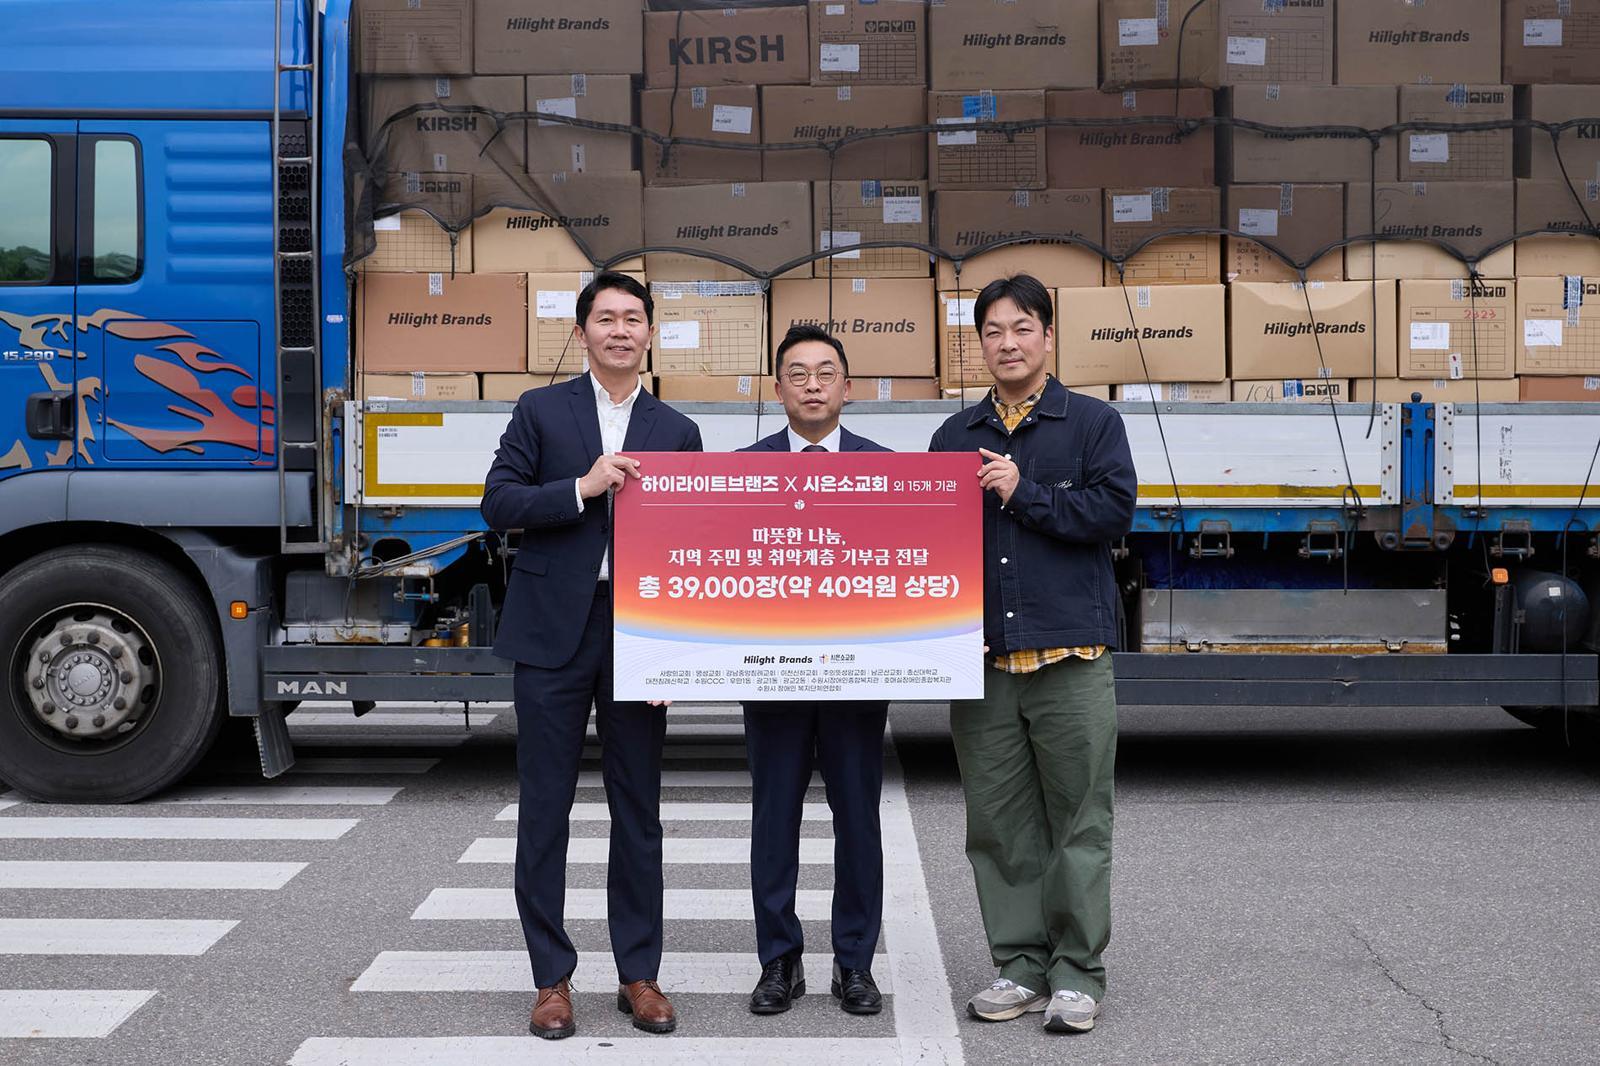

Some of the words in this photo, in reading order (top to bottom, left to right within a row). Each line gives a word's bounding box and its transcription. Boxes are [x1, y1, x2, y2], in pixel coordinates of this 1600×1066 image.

[507, 18, 556, 32] Hilight
[558, 18, 610, 30] Brands
[963, 34, 1013, 48] Hilight
[1014, 34, 1066, 46] Brands
[1369, 30, 1416, 46] Hilight
[1419, 30, 1470, 42] Brands
[669, 35, 784, 65] KIRSH
[417, 117, 477, 131] KIRSH
[1577, 124, 1600, 139] KI
[793, 126, 842, 140] Hilight
[1079, 132, 1128, 147] Hilight
[1130, 132, 1182, 145] Brands
[506, 217, 556, 231] Hilight
[557, 214, 610, 228] Brands
[677, 226, 724, 240] Hilight
[727, 224, 778, 237] Brands
[1431, 225, 1482, 237] Brands
[388, 313, 438, 328] Hilight
[441, 313, 492, 326] Brands
[852, 318, 915, 333] Brands
[1091, 328, 1139, 343] Hilight
[1142, 326, 1193, 339] Brands
[1264, 322, 1312, 337] Hilight
[1315, 322, 1366, 335] Brands
[3, 351, 54, 361] 15.290
[641, 475, 779, 493] 하이라이트브랜즈
[785, 477, 798, 492] X
[803, 475, 888, 493] 시은소교회
[893, 480, 905, 492] 외
[907, 480, 932, 492] 15개
[935, 480, 957, 492] 기관
[752, 528, 802, 545] 따뜻한
[808, 528, 846, 546] 나눔,
[668, 549, 701, 566] 지역
[707, 549, 741, 566] 주민
[747, 549, 763, 566] 및
[768, 549, 835, 566] 취약계층
[841, 549, 891, 566] 기부금
[896, 549, 929, 566] 전달
[638, 576, 661, 598] 총
[668, 575, 812, 600] 39,000장(약
[818, 576, 897, 598] 40억원
[904, 575, 960, 599] 상당)
[744, 655, 775, 666] Hilight
[779, 655, 813, 664] Brands
[277, 681, 347, 694] MAN
